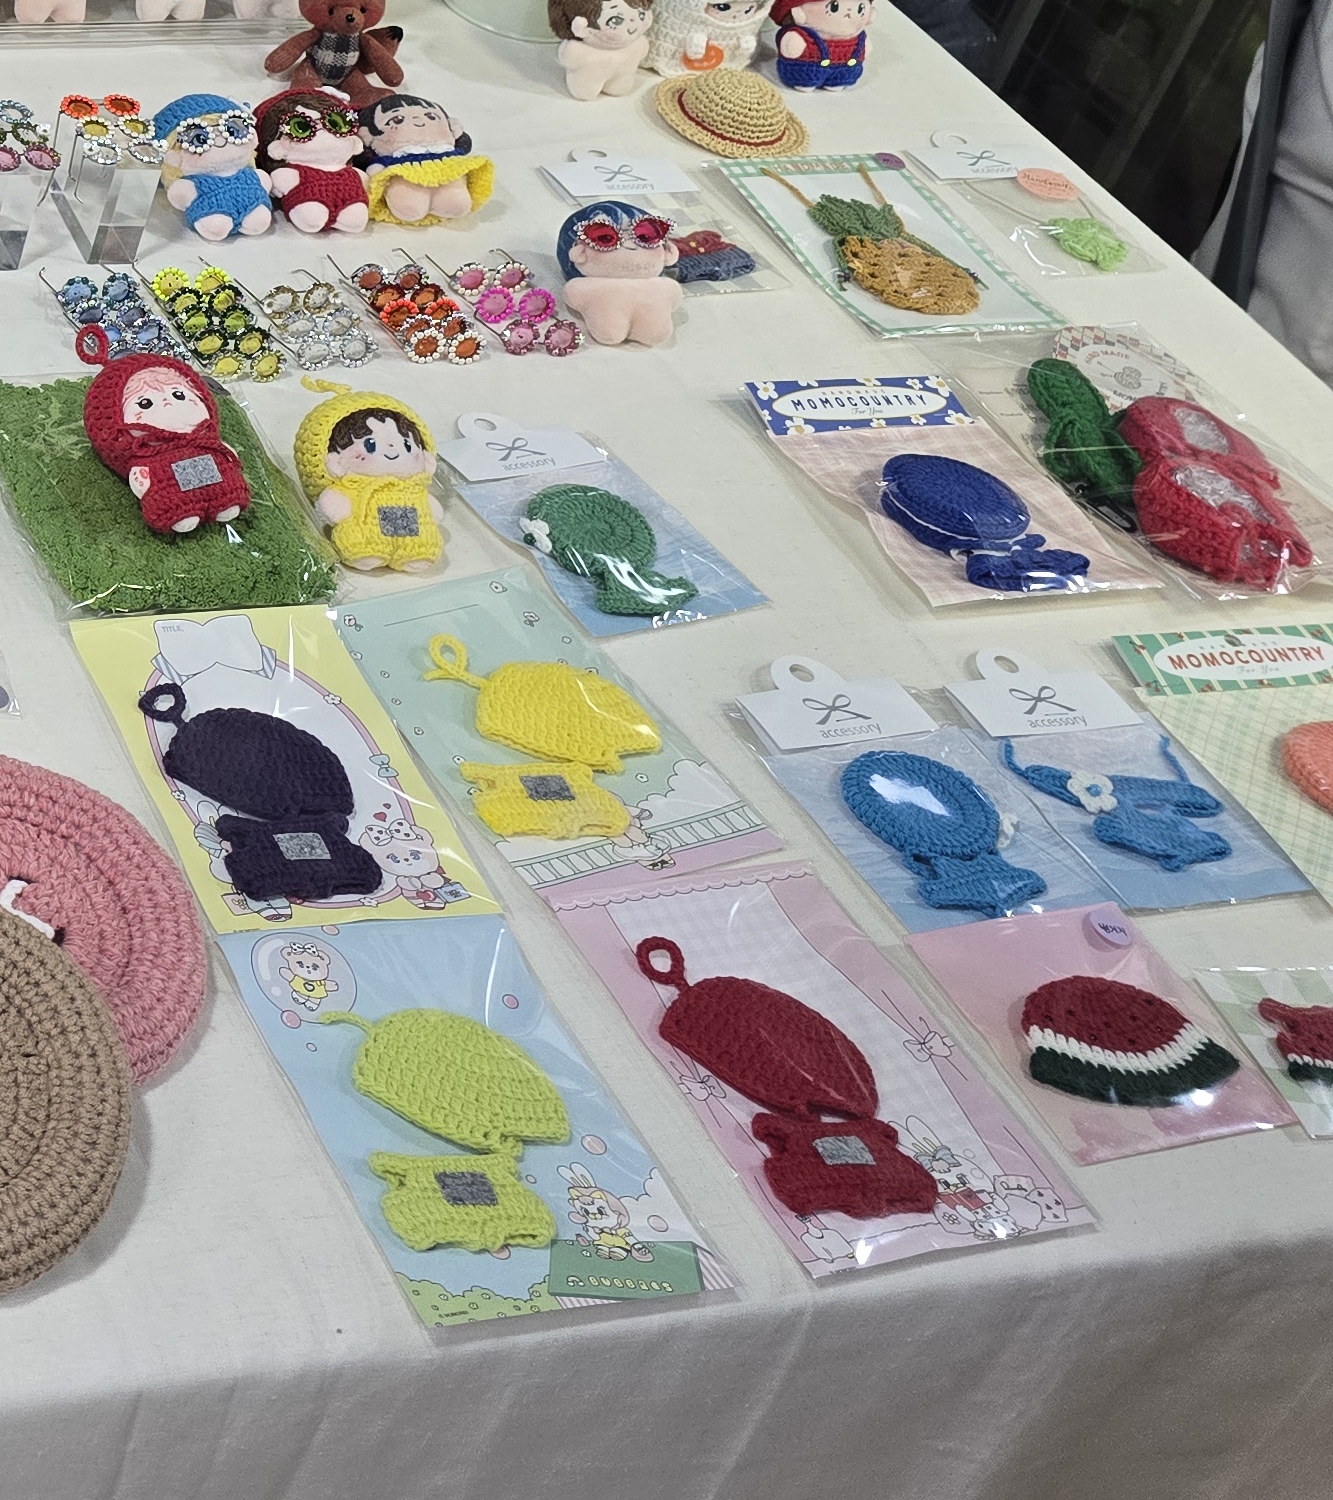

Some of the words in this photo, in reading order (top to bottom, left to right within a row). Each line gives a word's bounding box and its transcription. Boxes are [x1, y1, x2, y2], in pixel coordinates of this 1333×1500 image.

[790, 393, 928, 412] MOMOCOUNTRY
[501, 457, 556, 472] accessory
[1167, 646, 1327, 671] MOMOCOUNTRY
[819, 722, 883, 739] accessory
[1026, 715, 1088, 729] accessory
